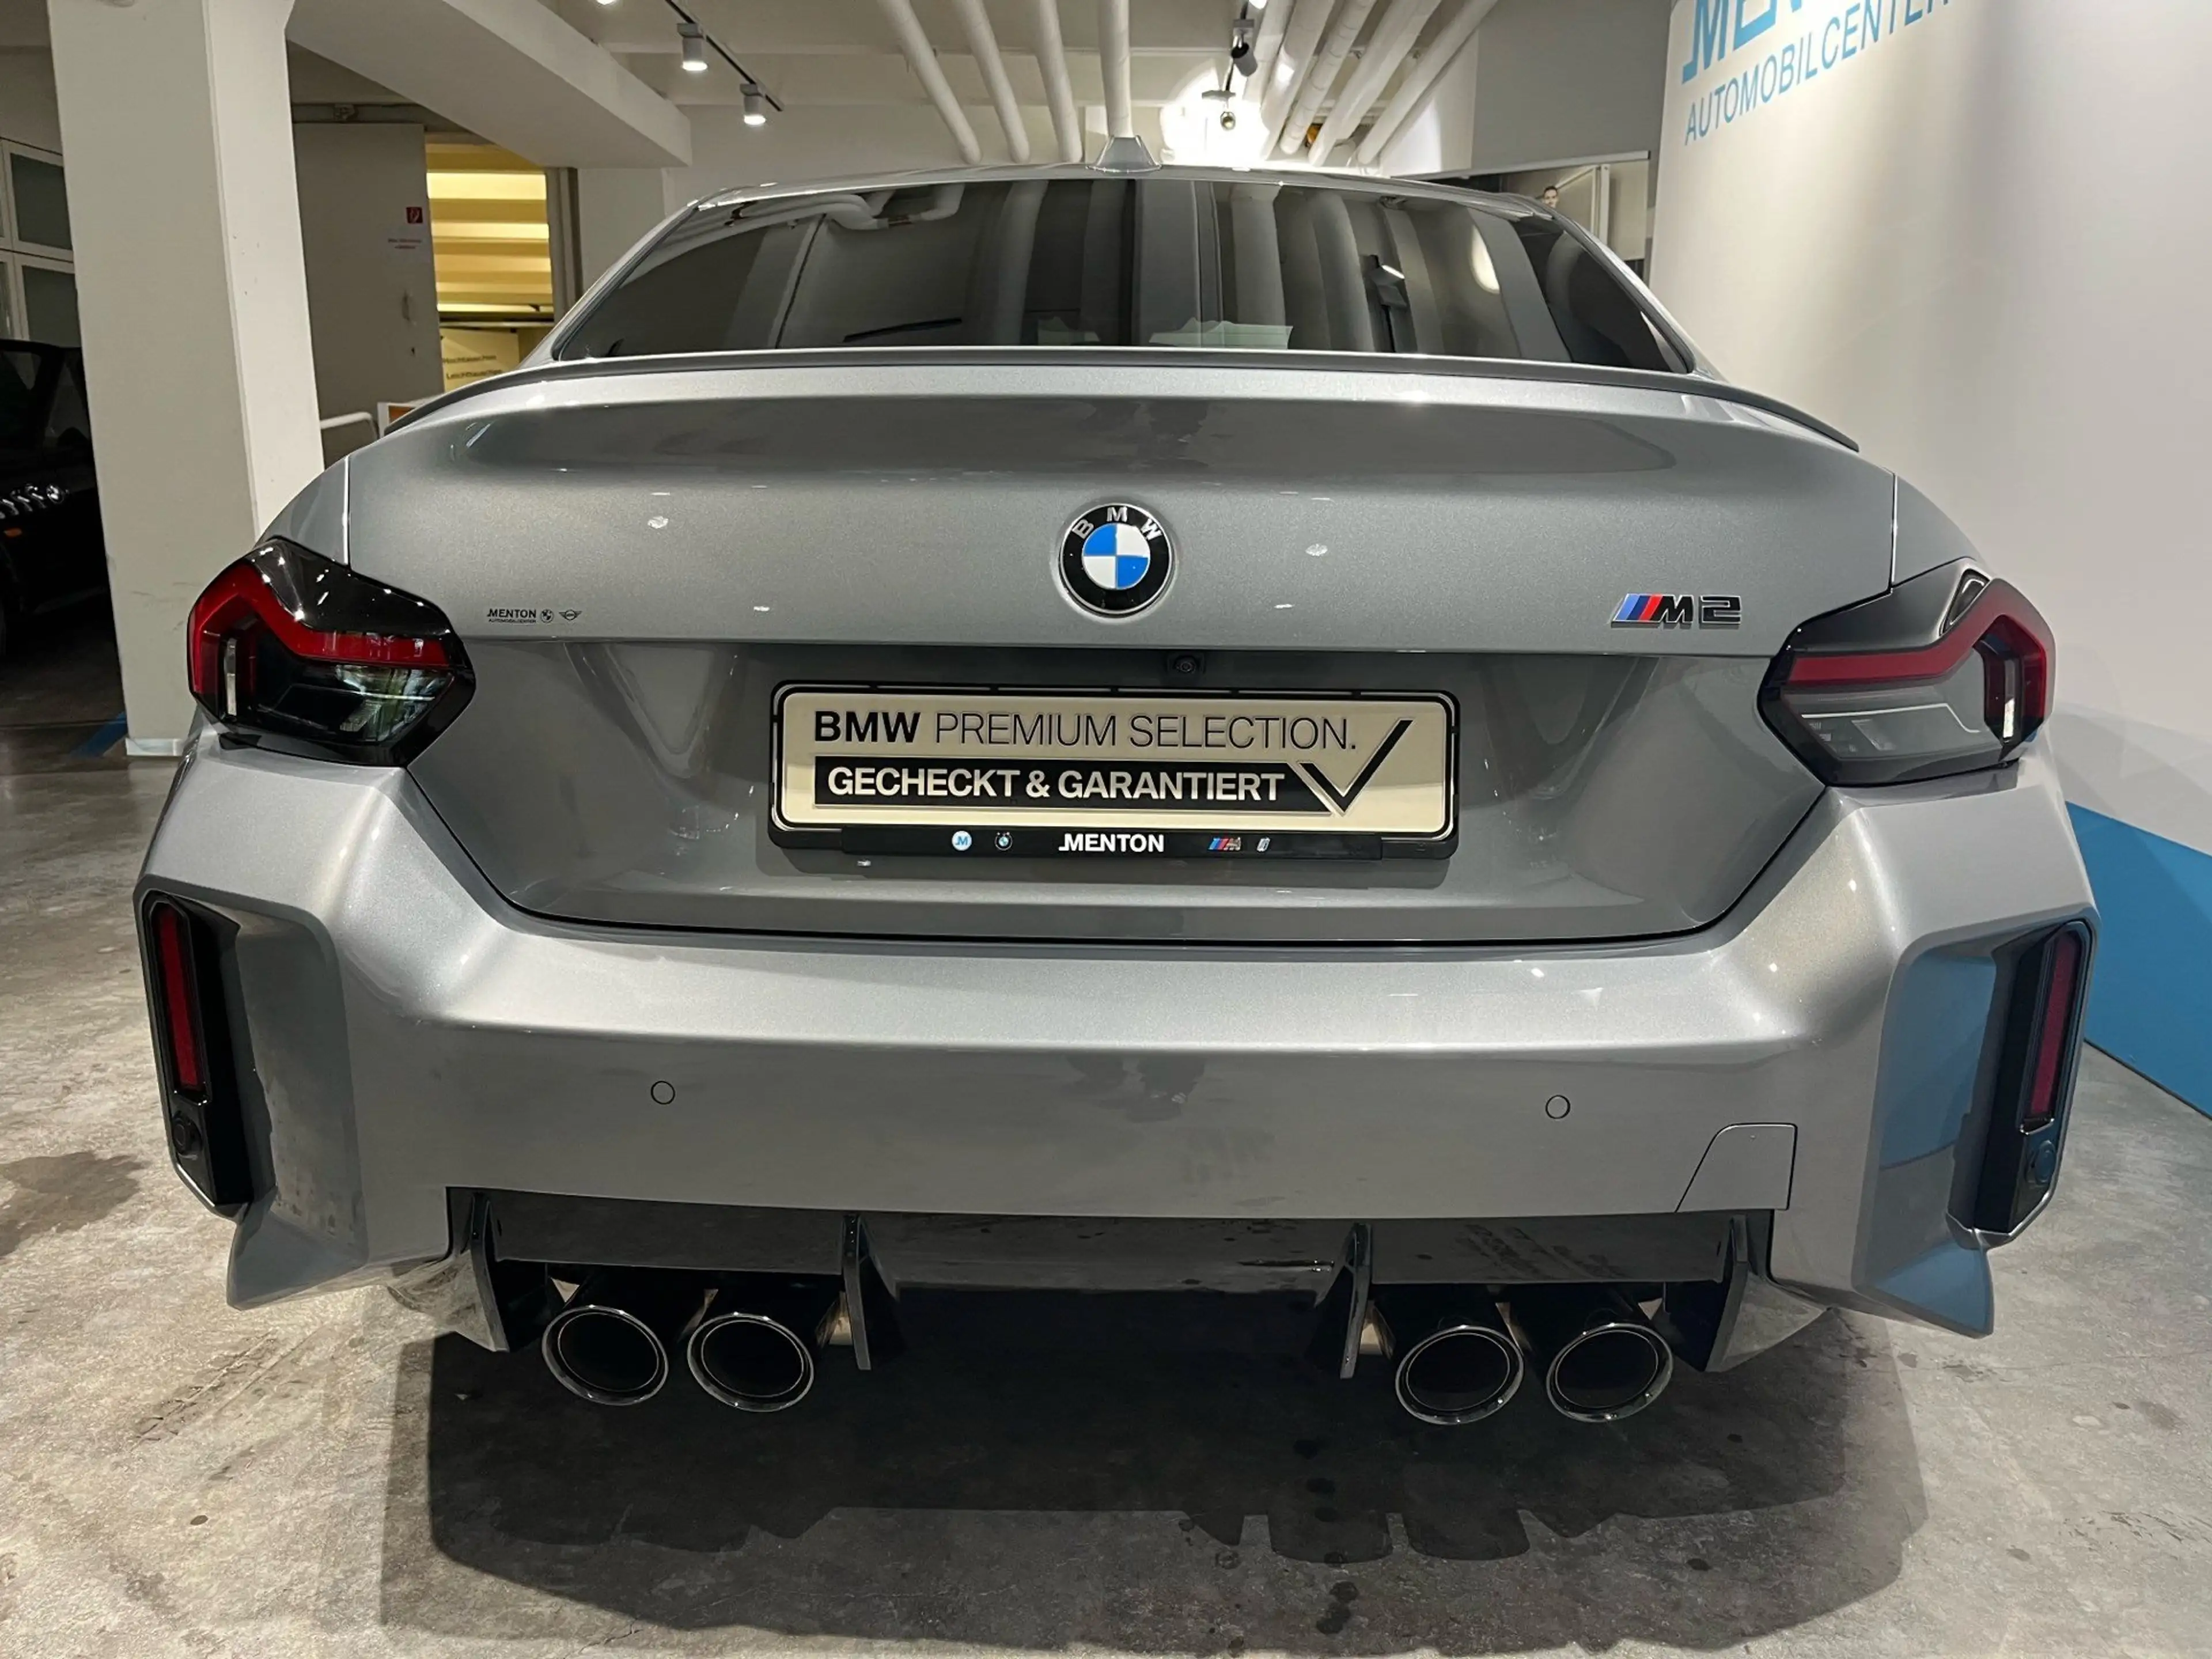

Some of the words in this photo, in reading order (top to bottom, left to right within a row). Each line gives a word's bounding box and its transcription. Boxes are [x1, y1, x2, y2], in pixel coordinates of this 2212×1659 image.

[1071, 506, 1162, 541] BMW
[487, 608, 536, 618] MENTON
[1636, 594, 1742, 626] M2
[815, 711, 921, 743] BMW
[936, 713, 1116, 747] PREMIUM
[1130, 715, 1356, 749] SELECTION.
[828, 767, 1021, 798] GECHECKT
[1025, 770, 1051, 799] &
[1058, 770, 1286, 801] GARANTIERT
[1058, 833, 1164, 852] MENTON
